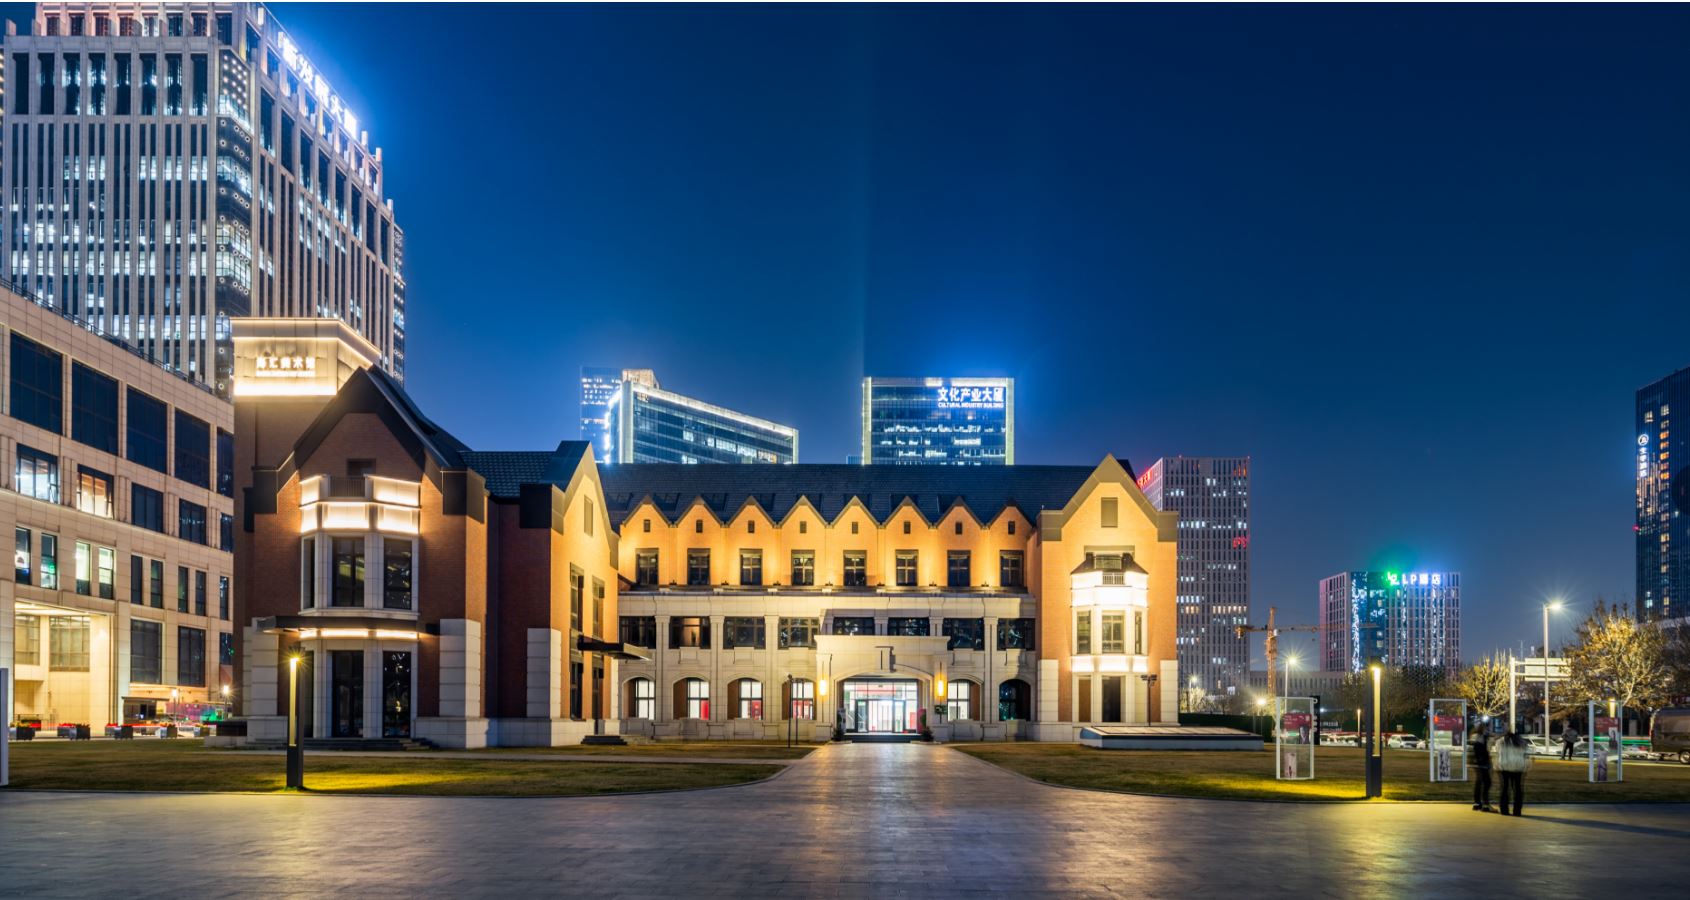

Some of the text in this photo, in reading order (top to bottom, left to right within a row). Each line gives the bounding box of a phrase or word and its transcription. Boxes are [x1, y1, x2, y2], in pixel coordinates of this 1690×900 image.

[938, 387, 1004, 401] 文化产业大厦
